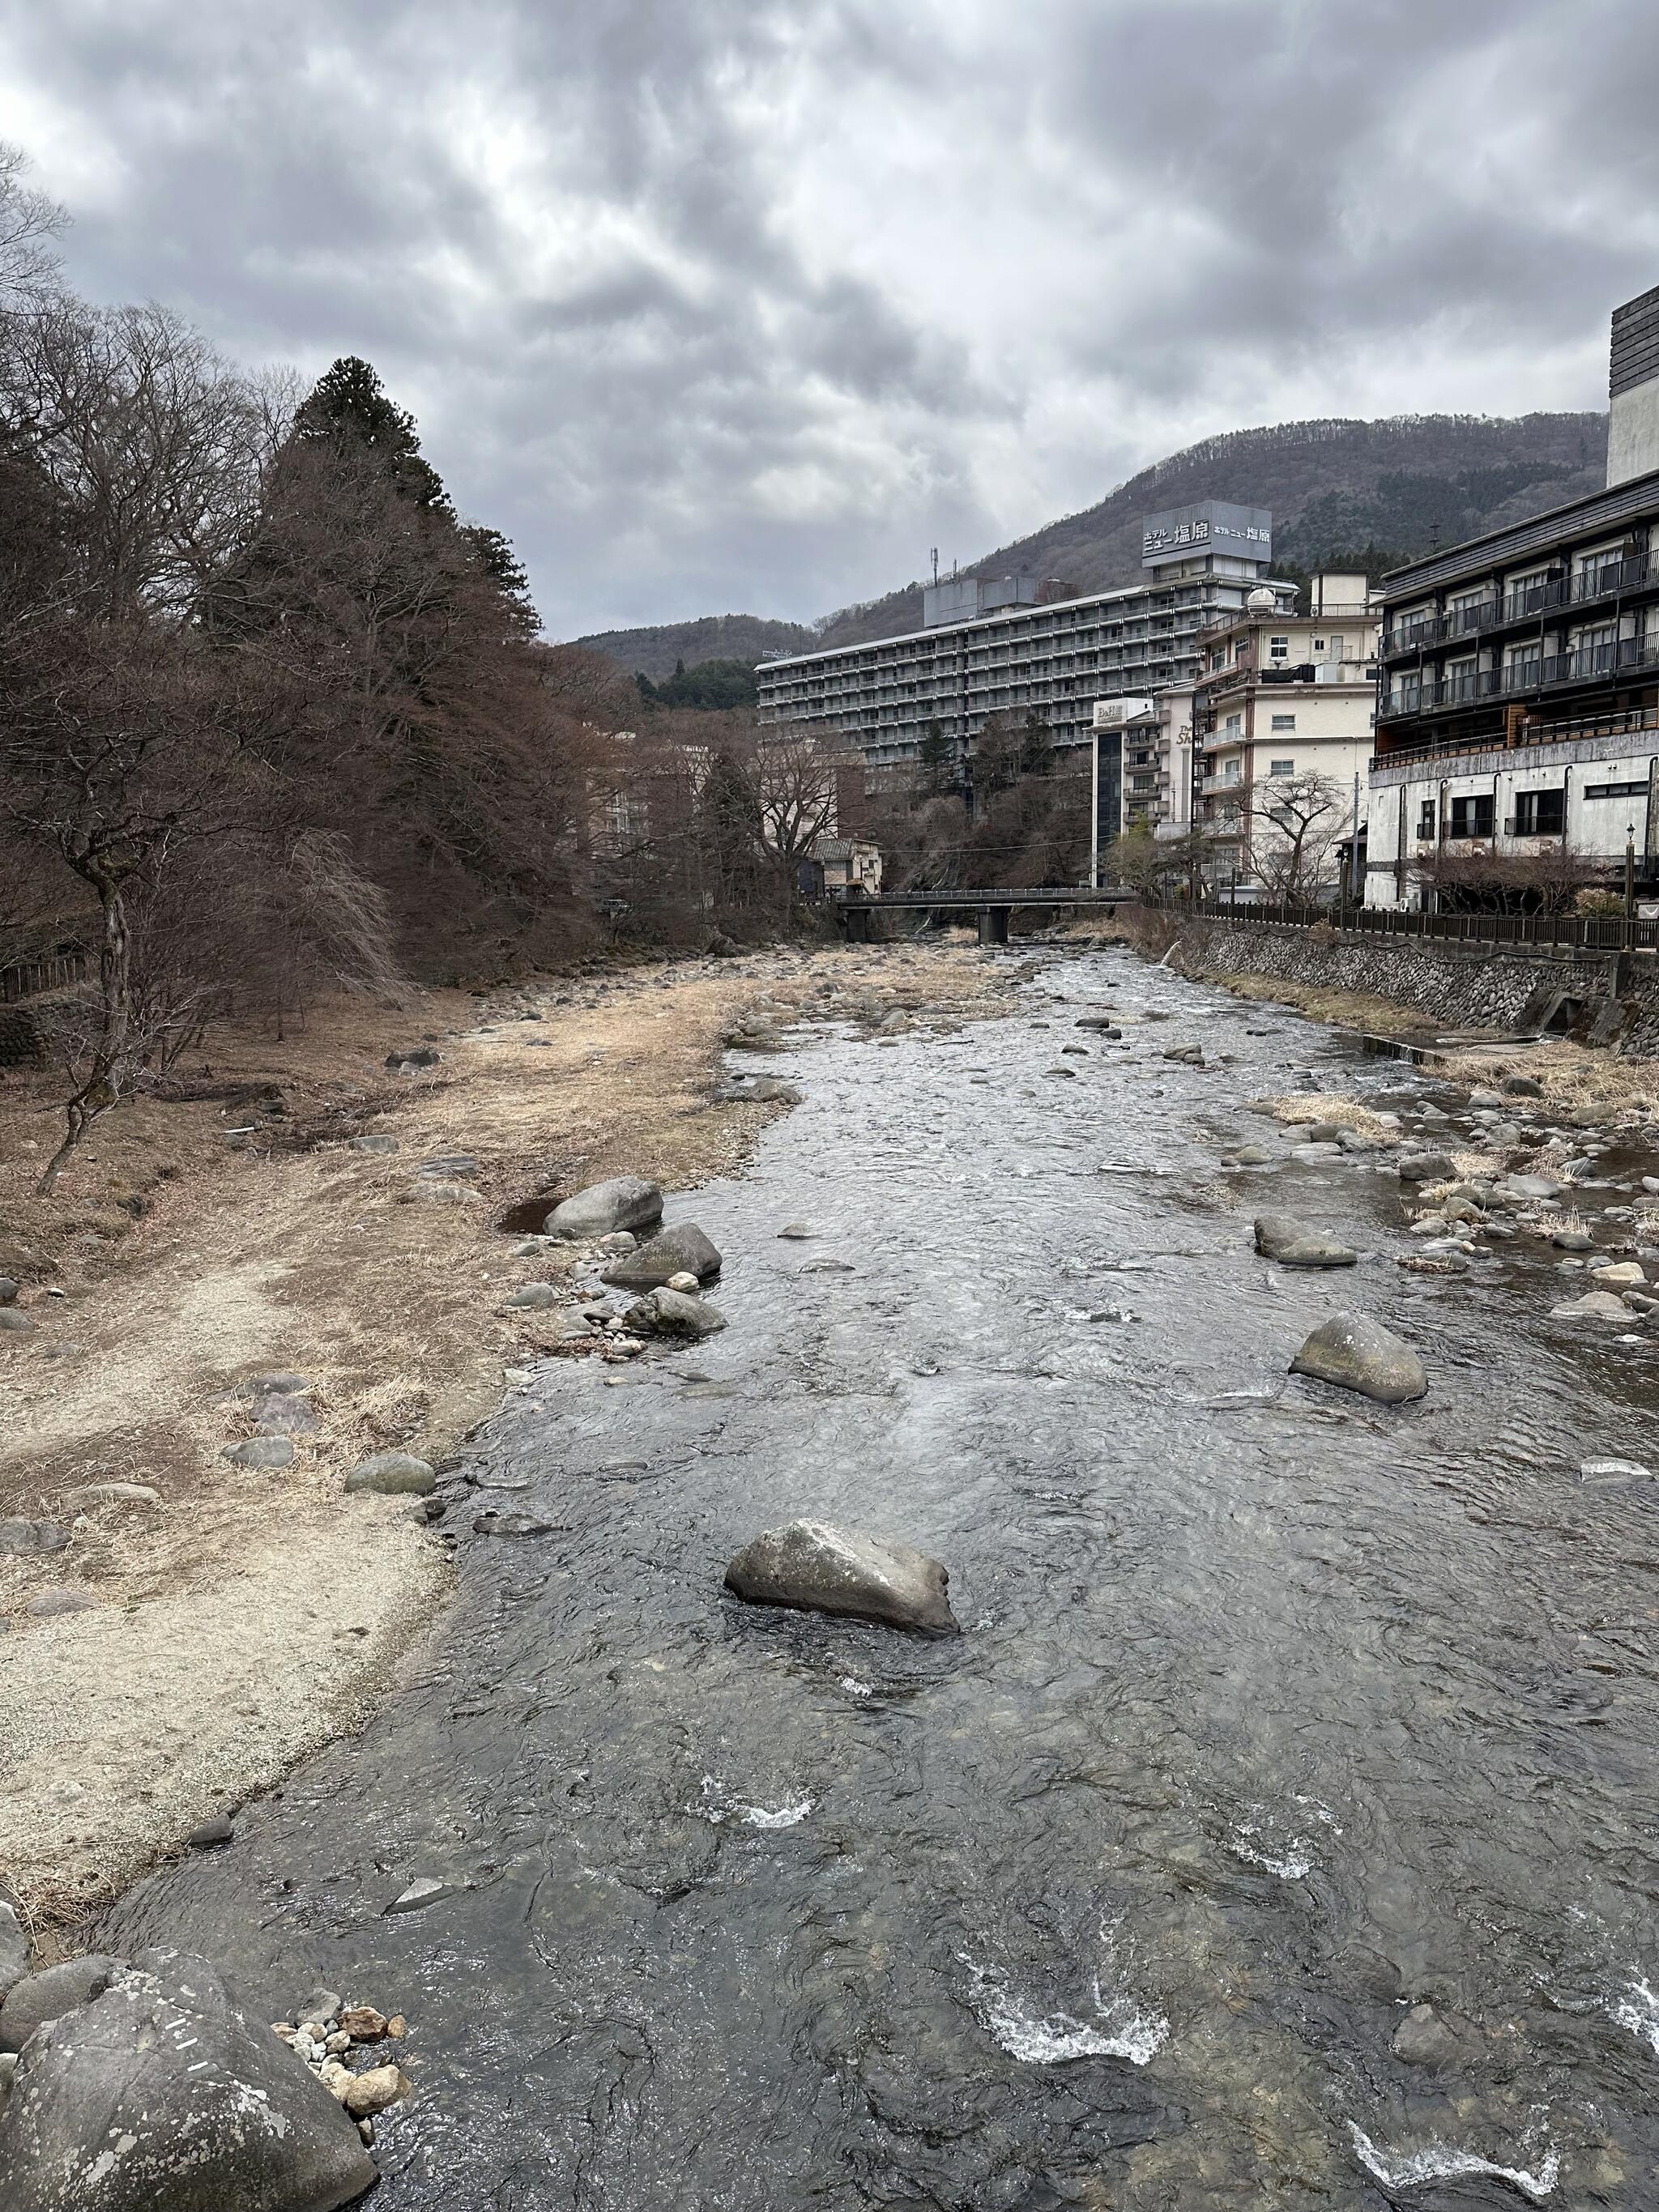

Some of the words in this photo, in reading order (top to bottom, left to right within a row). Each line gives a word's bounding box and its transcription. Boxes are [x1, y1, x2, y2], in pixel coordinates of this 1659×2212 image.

[1144, 528, 1167, 540] ホテル
[1174, 520, 1209, 544] 塩原
[1144, 538, 1173, 552] ニュー
